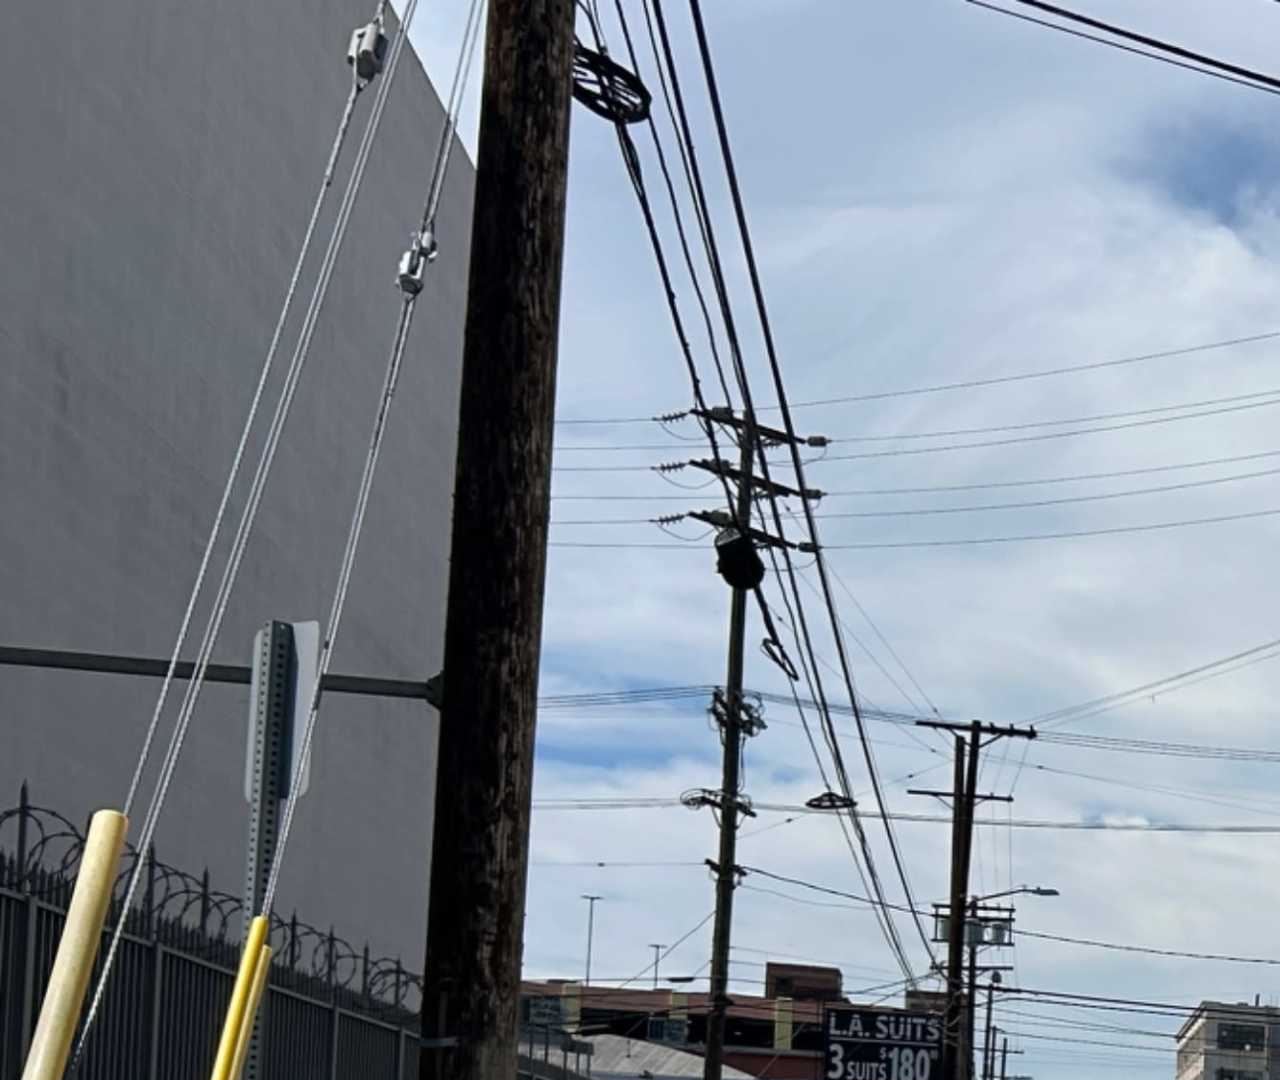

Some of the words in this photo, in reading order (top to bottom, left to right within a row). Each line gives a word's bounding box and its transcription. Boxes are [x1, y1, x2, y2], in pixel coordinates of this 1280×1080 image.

[829, 1012, 870, 1038] L.A.
[875, 1015, 941, 1041] SUITS
[827, 1043, 845, 1080] 3
